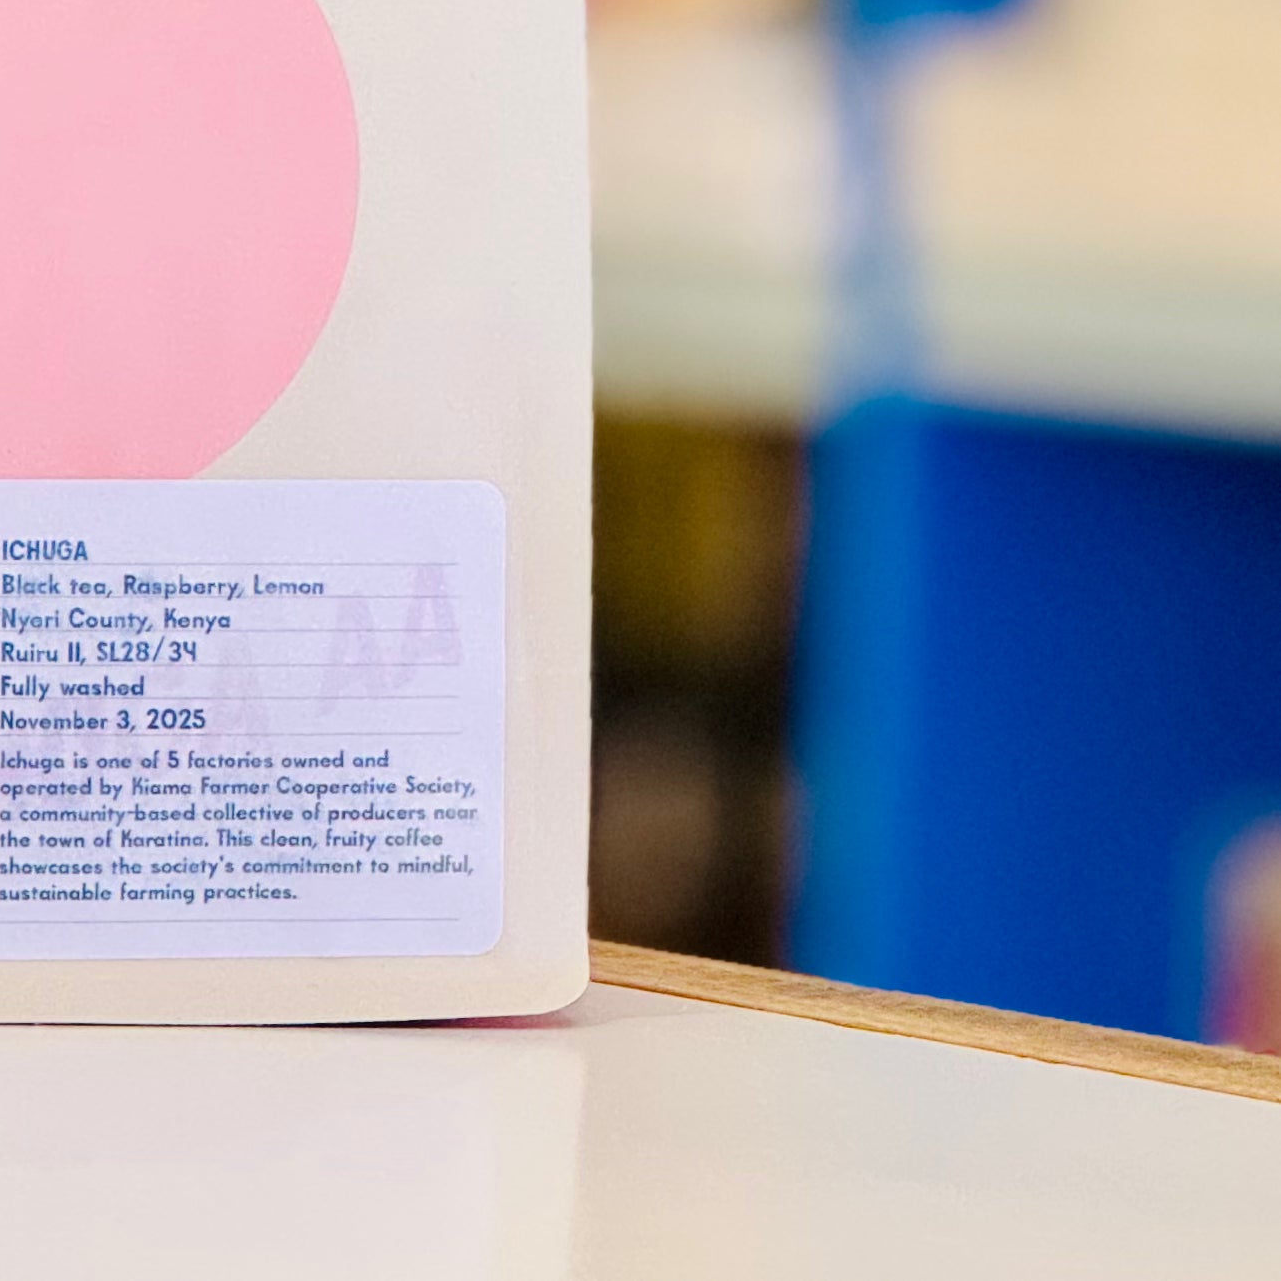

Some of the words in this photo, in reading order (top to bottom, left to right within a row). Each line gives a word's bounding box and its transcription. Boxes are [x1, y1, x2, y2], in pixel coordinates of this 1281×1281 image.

[2, 540, 89, 561] ICHUGA
[1, 574, 62, 596] Black
[69, 576, 114, 599] tea,
[123, 574, 246, 601] Raspberry,
[253, 574, 325, 596] Lemon
[0, 608, 60, 635] Nyeri
[69, 607, 154, 634] County,
[163, 608, 232, 635] Kenya
[0, 641, 59, 663] Ruiru
[96, 636, 197, 663] SL28/34
[0, 675, 51, 702] Fully
[59, 675, 146, 697] washed
[0, 710, 109, 731] November
[115, 710, 137, 733] 3,
[146, 708, 207, 730] 2025
[0, 750, 66, 774] Ichuga
[73, 751, 89, 769] is
[96, 755, 132, 769] one
[140, 750, 160, 769] of
[167, 750, 180, 769] 5
[188, 750, 274, 769] factories
[281, 750, 345, 769] owned
[352, 749, 390, 768] and
[0, 777, 92, 800] operated
[99, 777, 123, 801] by
[131, 776, 193, 795] Kiama
[200, 776, 270, 795] Farmer
[276, 776, 398, 800] Cooperative
[405, 775, 477, 799] Society,
[0, 808, 12, 822] a
[19, 802, 196, 827] community-based
[202, 802, 294, 822] collective
[302, 802, 322, 821] of
[327, 802, 427, 825] producers
[433, 806, 479, 821] near
[0, 830, 31, 848] the
[38, 833, 86, 848] town
[93, 829, 114, 848] of
[120, 829, 210, 848] Karatina.
[216, 828, 254, 847] This
[260, 828, 318, 850] clean,
[325, 827, 377, 853] fruity
[384, 827, 444, 847] coffee
[111, 855, 143, 875] the
[150, 854, 235, 880] society's
[241, 856, 363, 874] commitment
[370, 859, 390, 874] to
[397, 854, 475, 877] mindful,
[120, 881, 196, 905] farming
[203, 882, 298, 904] practices.
